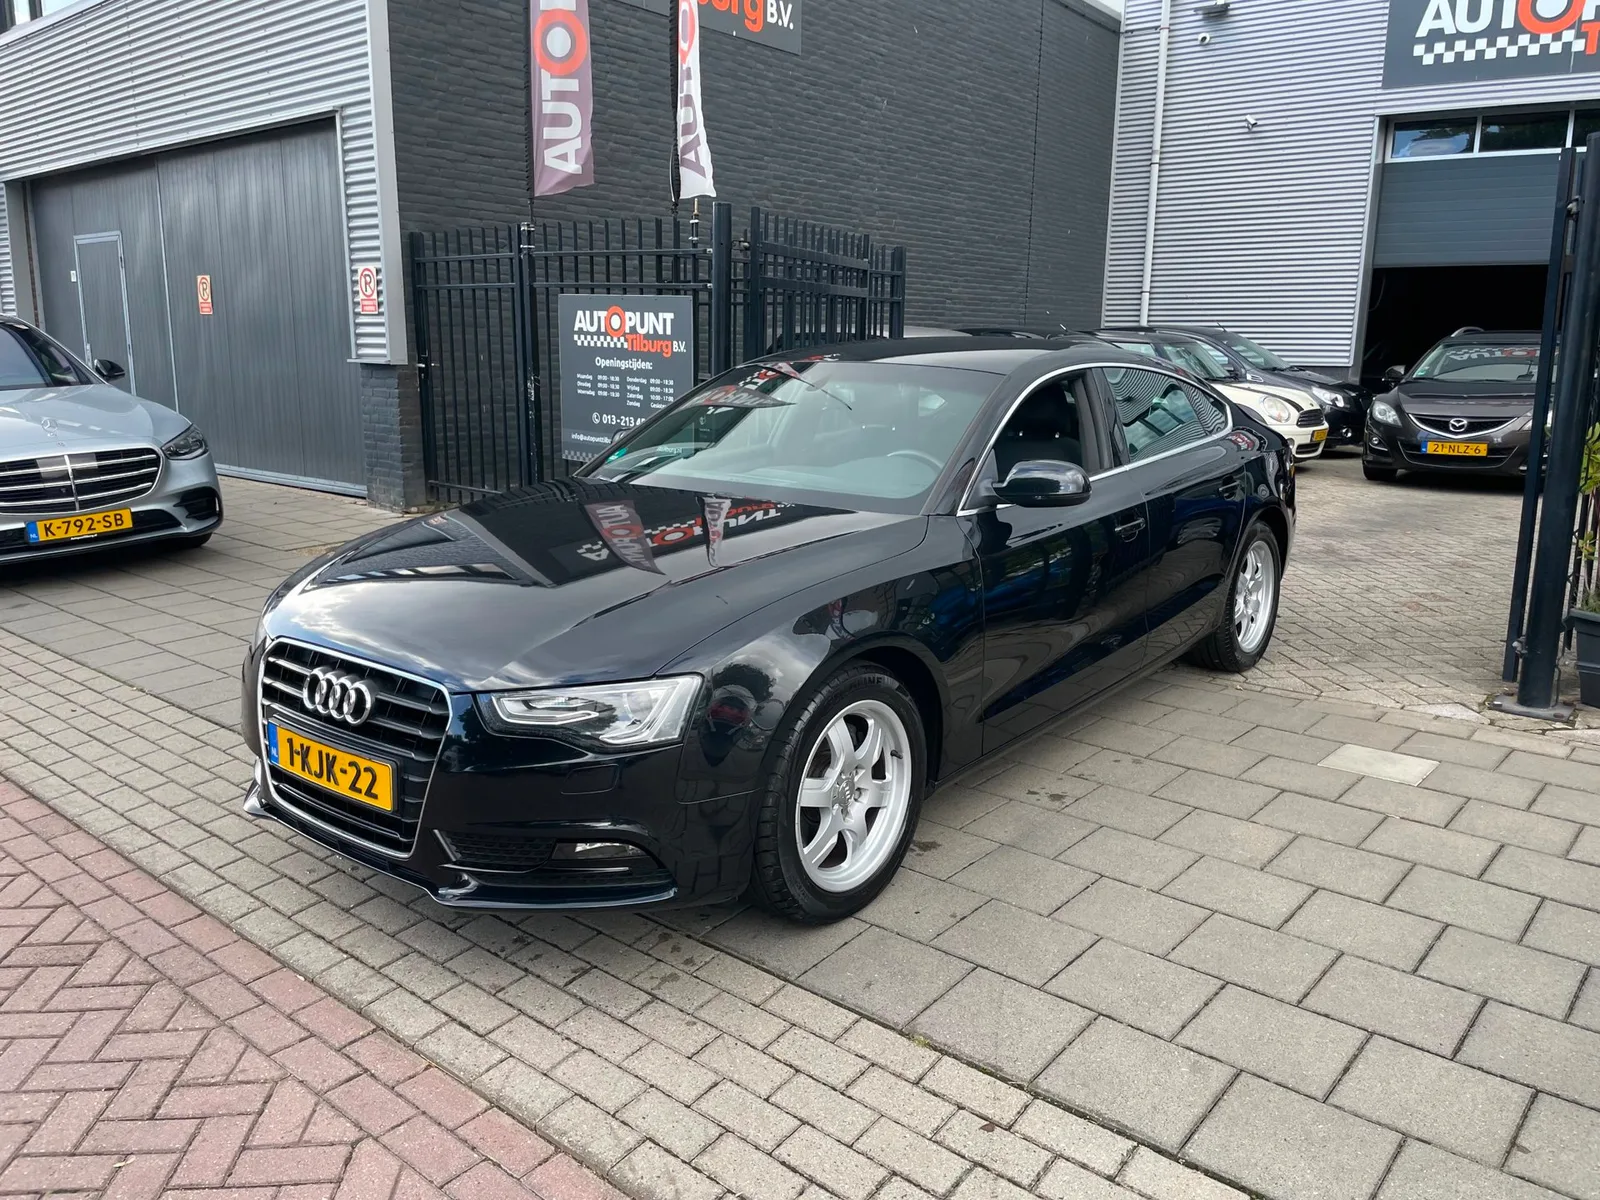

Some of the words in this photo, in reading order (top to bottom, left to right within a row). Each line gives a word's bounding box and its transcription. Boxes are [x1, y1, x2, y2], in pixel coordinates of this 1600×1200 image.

[1415, 0, 1600, 38] AUTO
[533, 0, 589, 175] AUTO
[573, 305, 675, 338] AUTOPUNT
[626, 333, 672, 358] Tilburg
[673, 340, 687, 353] B.V.
[595, 356, 653, 371] Openingstijden:
[1433, 443, 1481, 455] 21-NLZ-6
[44, 513, 124, 537] K-792-SB
[286, 737, 379, 800] 1-KJK-22
